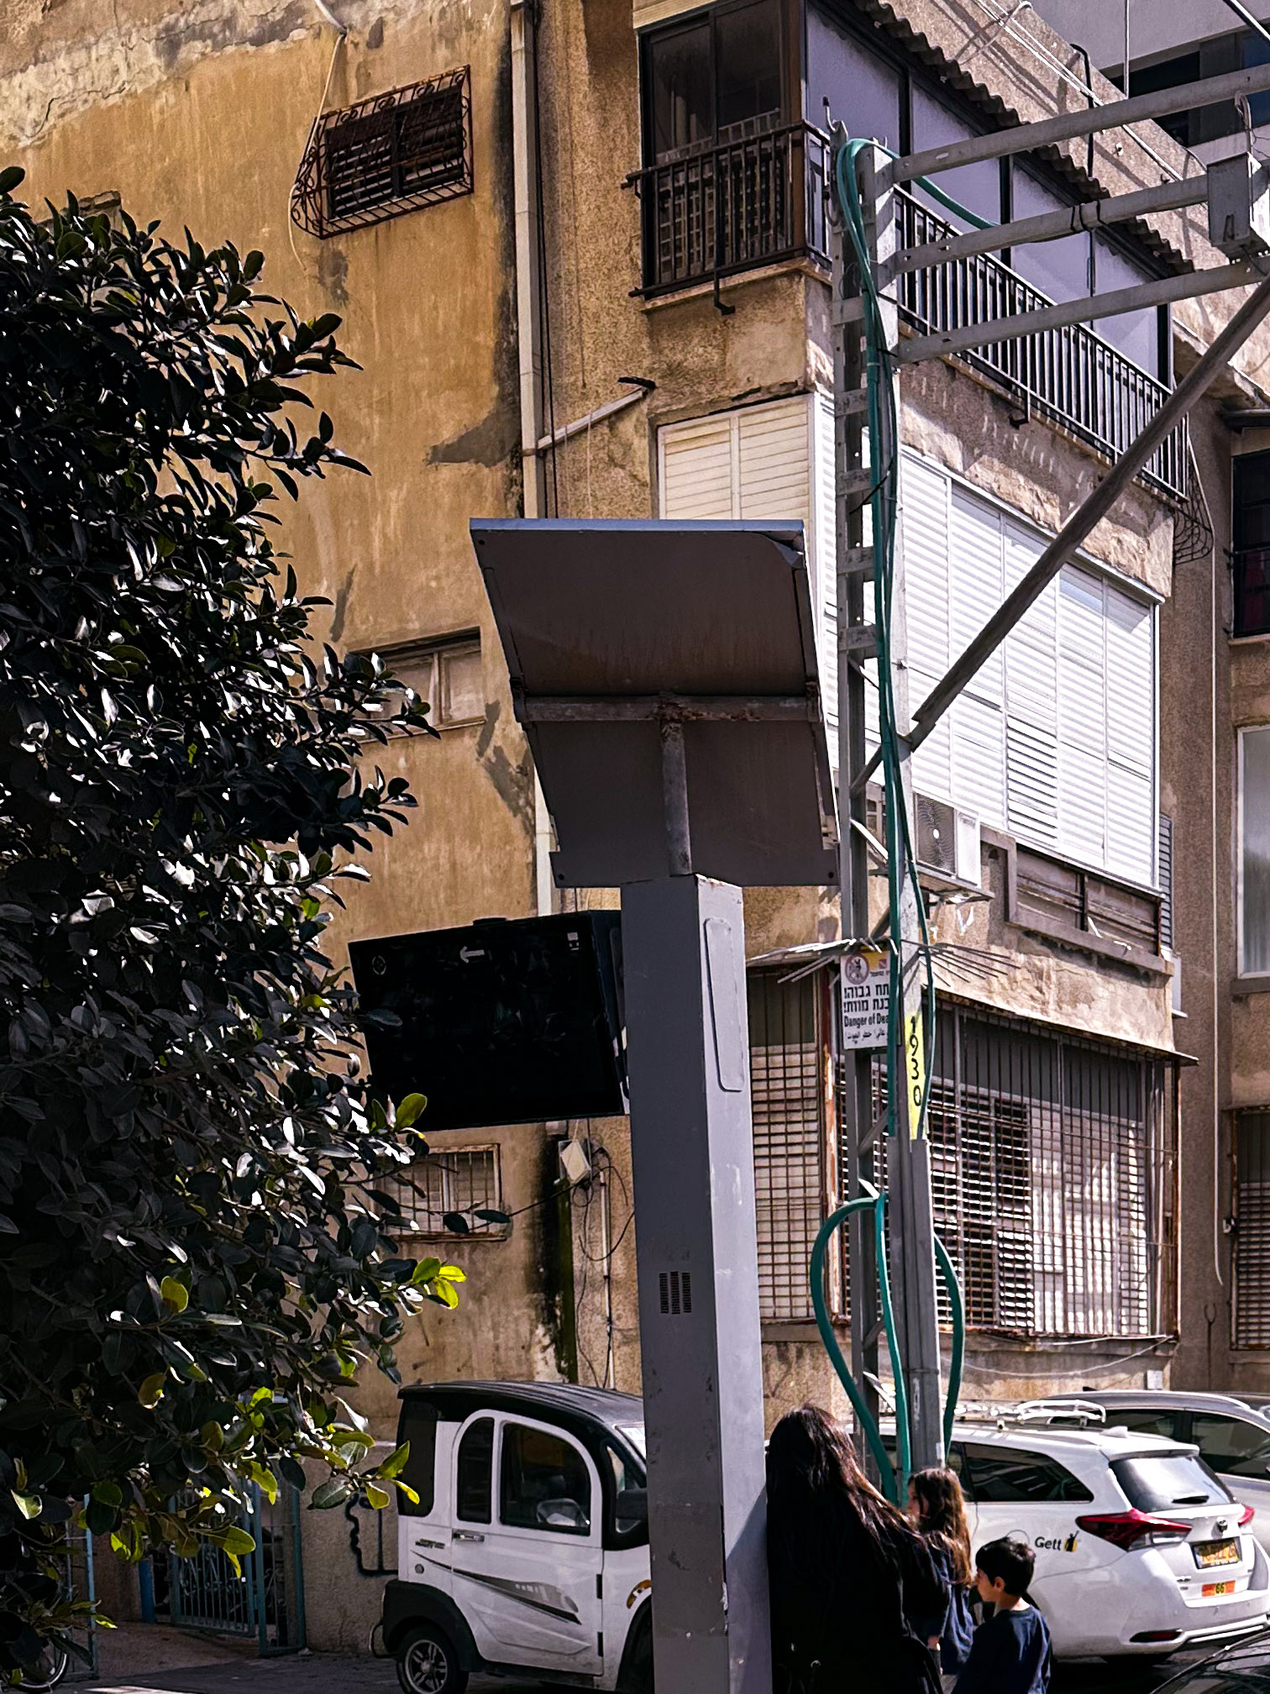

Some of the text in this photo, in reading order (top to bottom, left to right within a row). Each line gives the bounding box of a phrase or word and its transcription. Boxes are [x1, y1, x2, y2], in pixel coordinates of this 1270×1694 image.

[844, 984, 890, 999] תח גבוה!
[843, 998, 889, 1013] כנת מוות!
[844, 1013, 889, 1028] Danger of Dea
[909, 1016, 922, 1107] 1930
[1034, 1536, 1062, 1551] Gett
